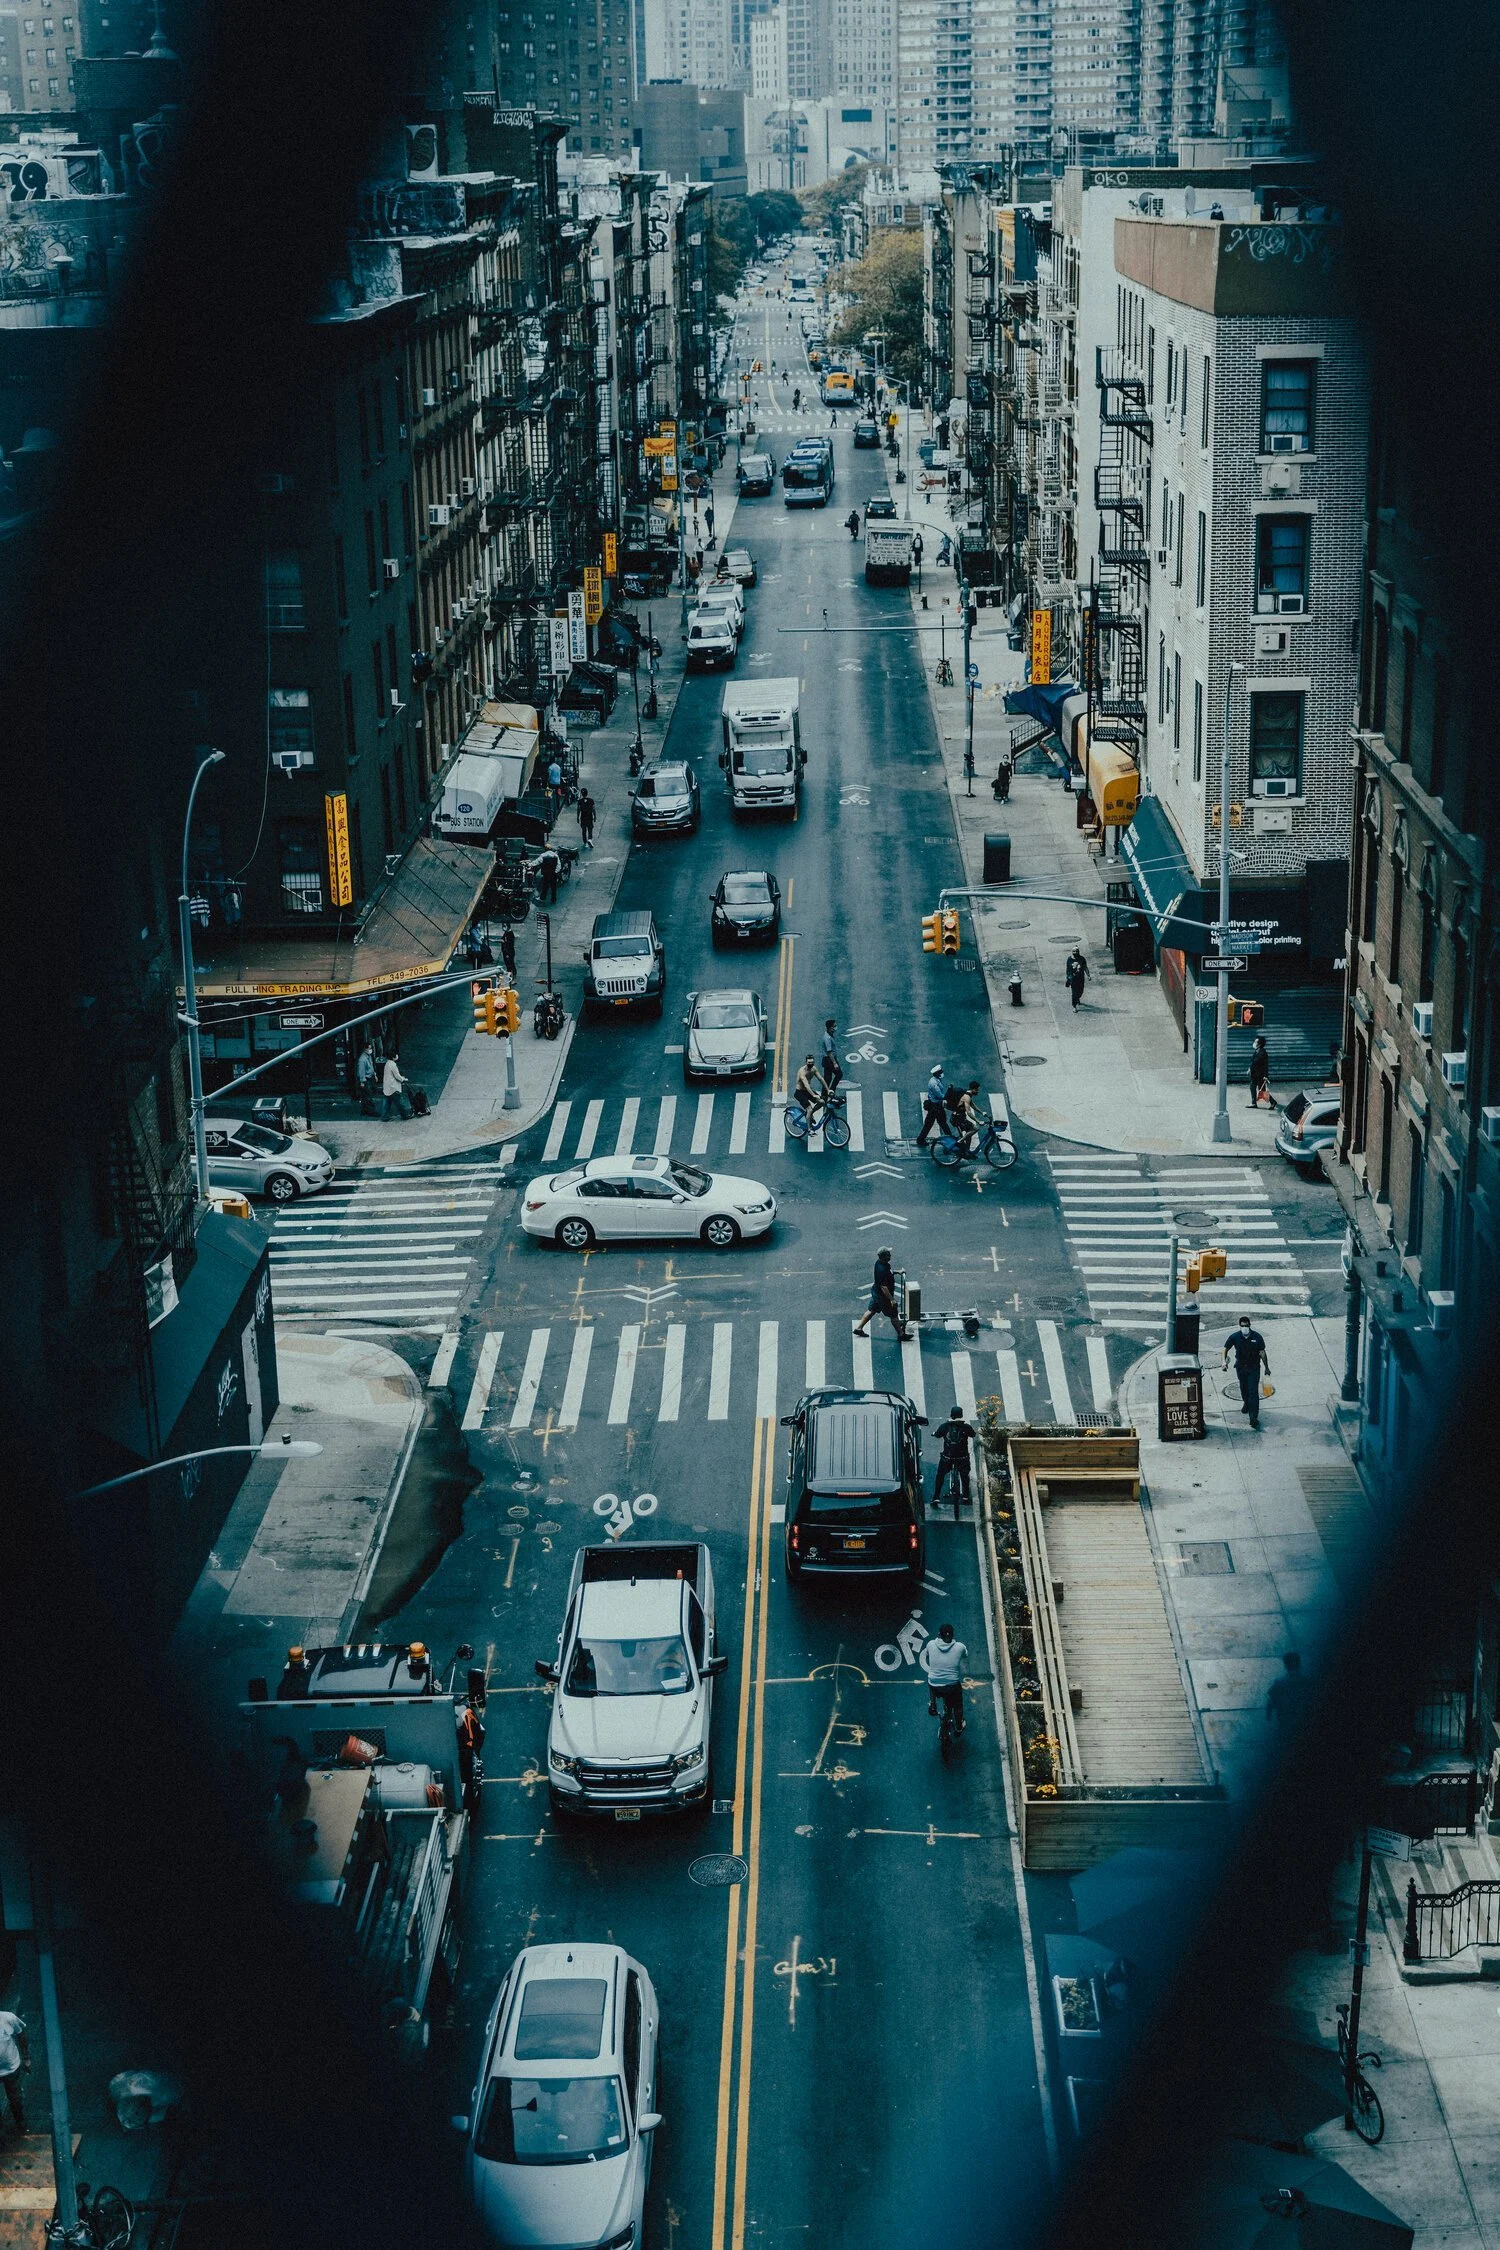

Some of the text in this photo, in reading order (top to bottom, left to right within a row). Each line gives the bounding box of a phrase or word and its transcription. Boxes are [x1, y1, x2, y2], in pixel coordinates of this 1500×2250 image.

[1034, 613, 1043, 682] 日月洗衣店
[451, 817, 484, 828] BUS STATION
[1248, 919, 1279, 929] design
[1273, 935, 1302, 945] printing
[389, 965, 429, 982] 349-7036
[252, 985, 275, 993] HING
[279, 985, 322, 993] TRADING
[1167, 1410, 1189, 1422] LOVE
